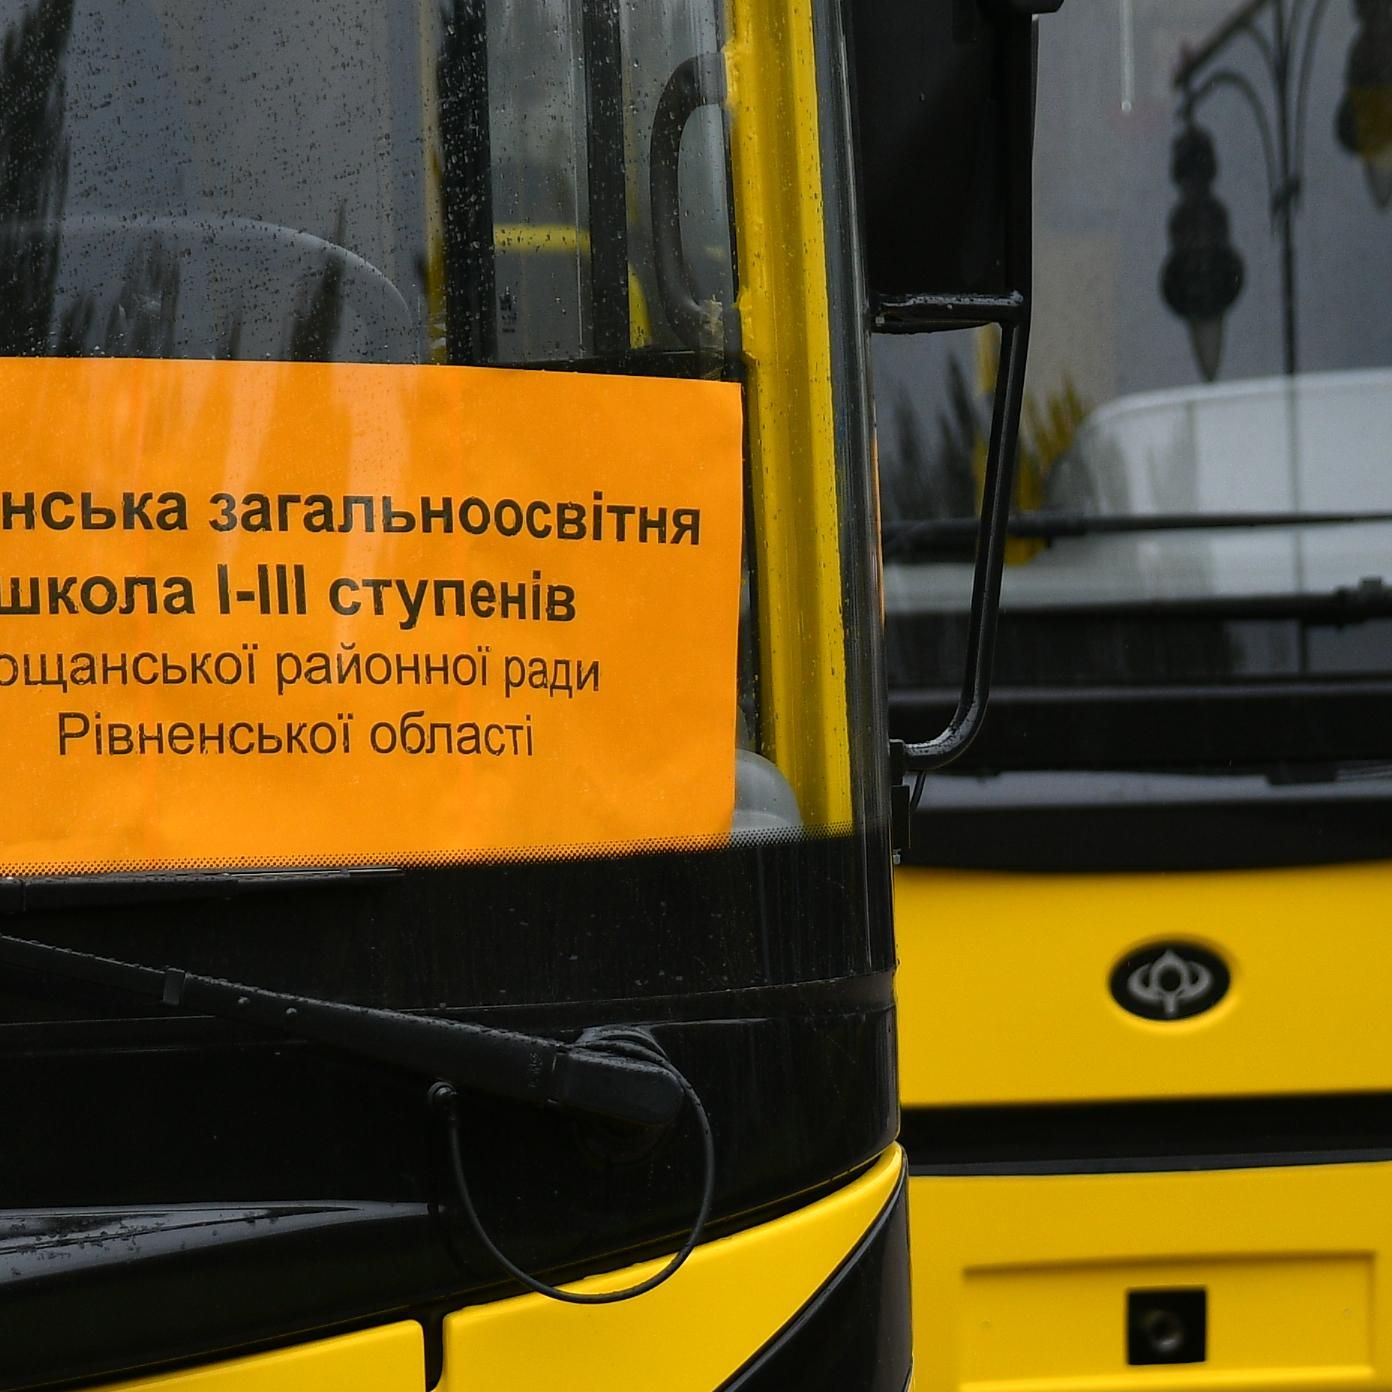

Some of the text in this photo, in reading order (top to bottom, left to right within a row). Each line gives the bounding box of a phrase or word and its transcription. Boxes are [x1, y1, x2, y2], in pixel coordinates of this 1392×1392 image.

[208, 490, 701, 547] загальноосвітня
[328, 570, 576, 631] ступенів
[275, 642, 489, 697] районної
[503, 654, 600, 700] ради
[57, 709, 533, 758] Рівненської області
